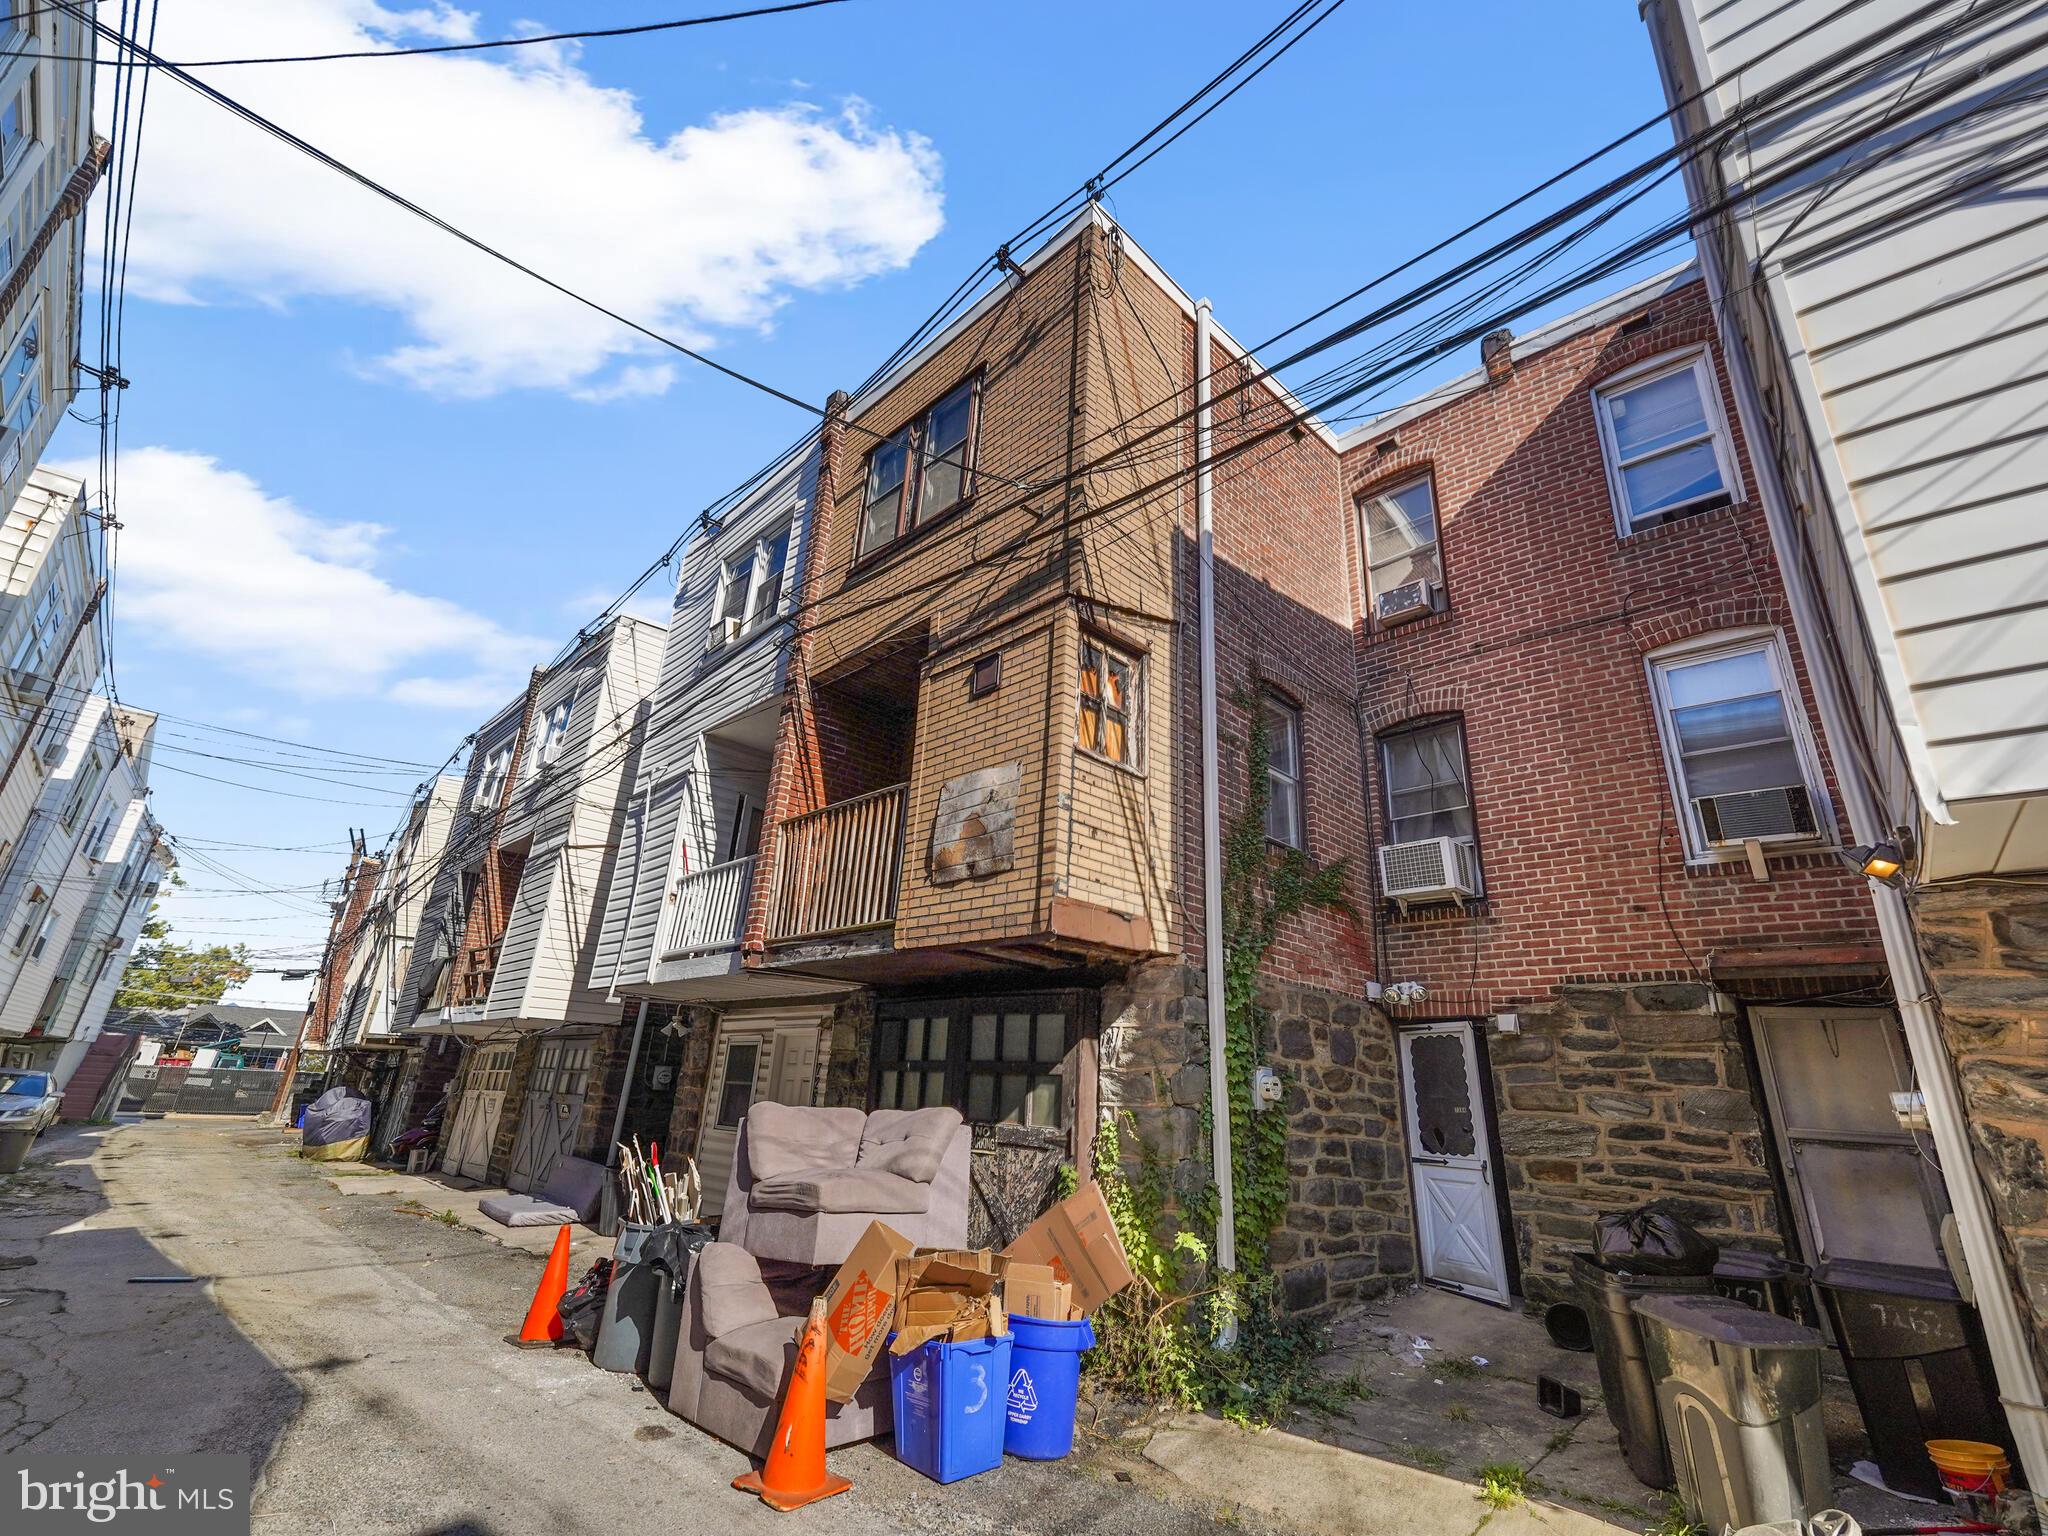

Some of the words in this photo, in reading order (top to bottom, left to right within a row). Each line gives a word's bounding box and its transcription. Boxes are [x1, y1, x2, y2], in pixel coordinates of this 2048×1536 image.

[972, 1136, 995, 1150] ARKING
[974, 1126, 990, 1137] NO
[838, 1303, 851, 1335] THE
[847, 1274, 868, 1355] HOME
[864, 1328, 877, 1349] How
[864, 1343, 875, 1360] get
[873, 1321, 888, 1345] more
[963, 1363, 988, 1414] 3
